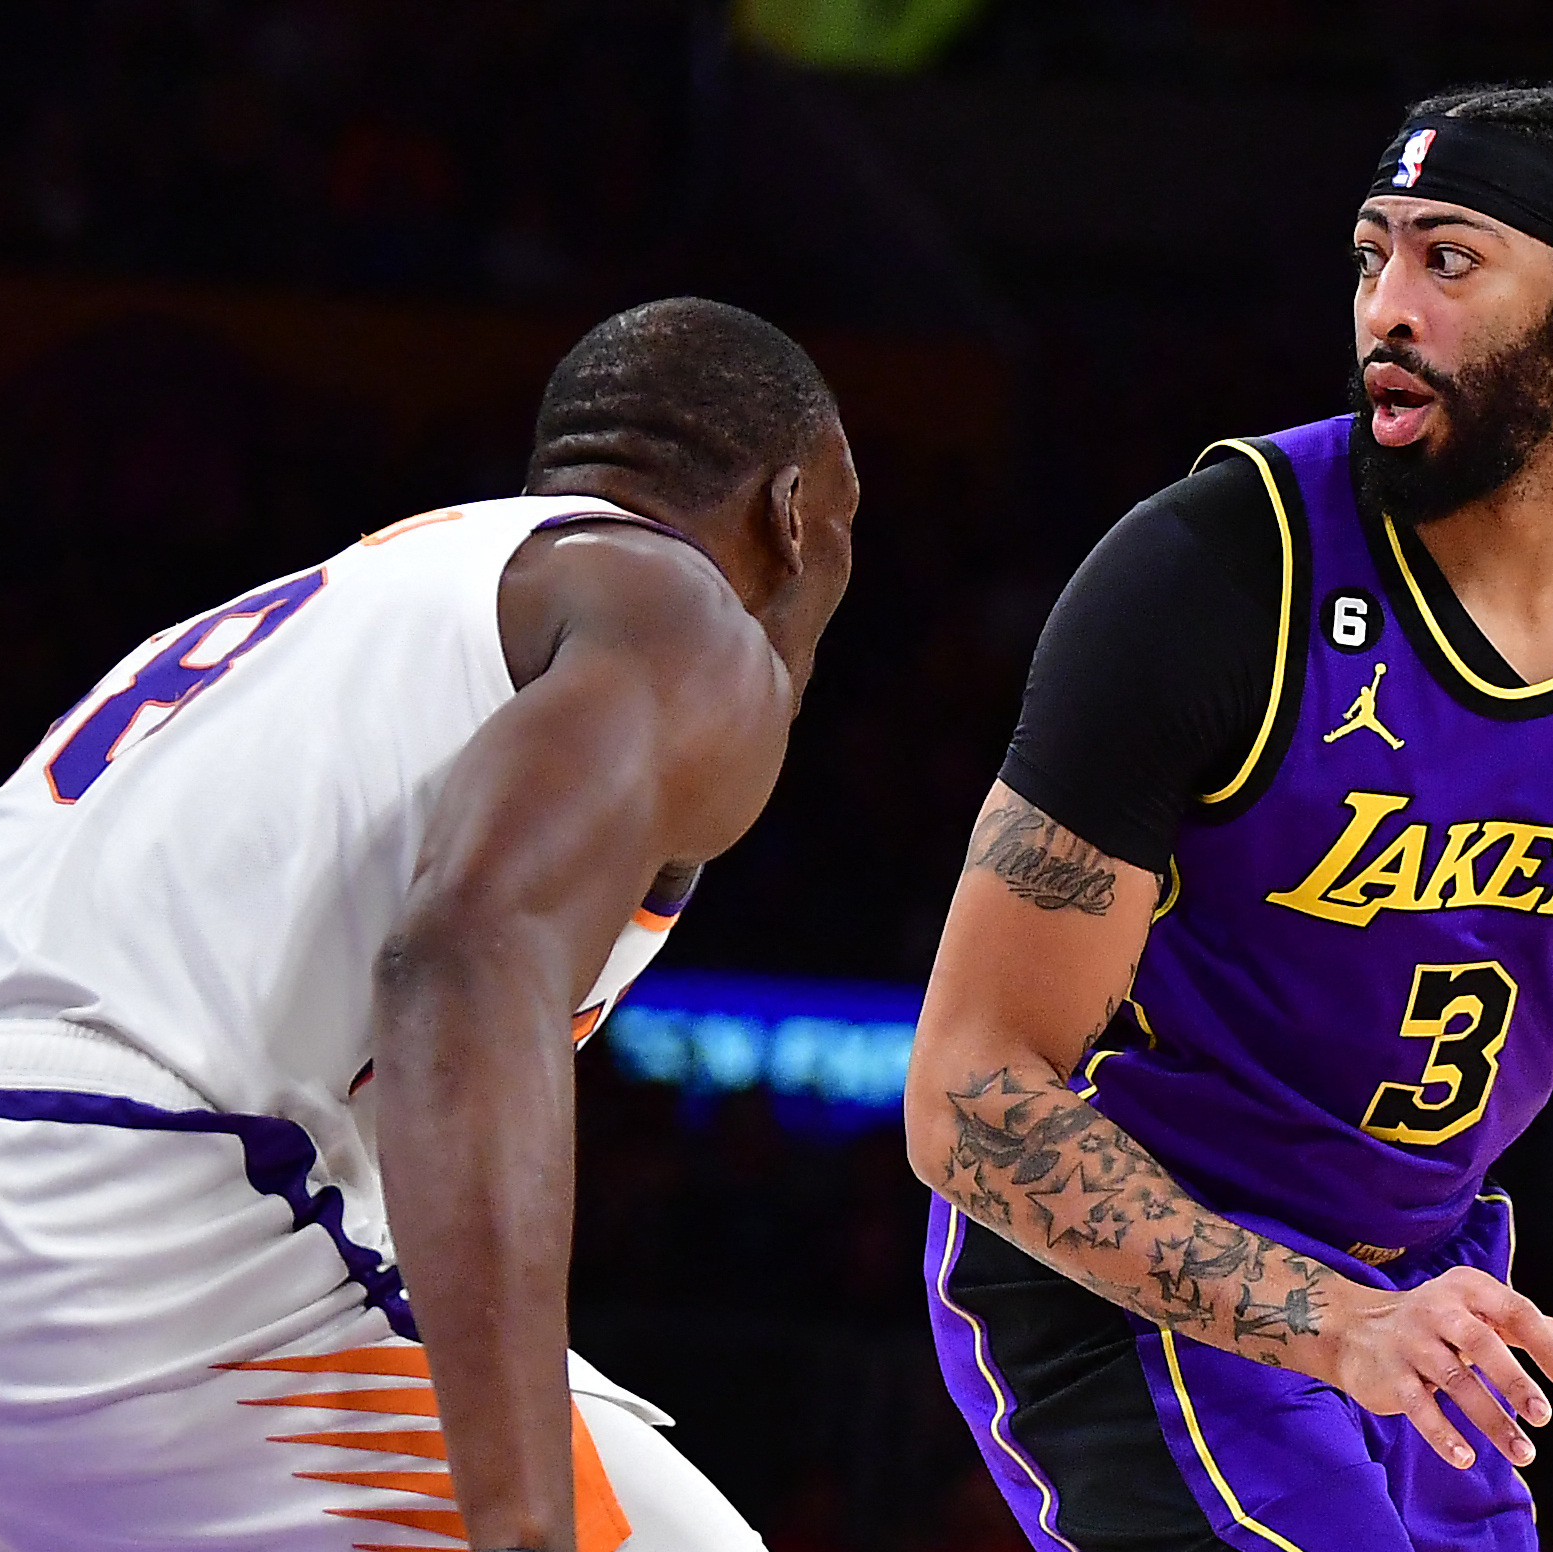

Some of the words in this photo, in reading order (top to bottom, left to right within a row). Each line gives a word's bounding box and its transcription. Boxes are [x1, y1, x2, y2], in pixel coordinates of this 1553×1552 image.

[8, 566, 329, 805] 8
[1331, 596, 1368, 646] 6
[1358, 960, 1519, 1146] 3
